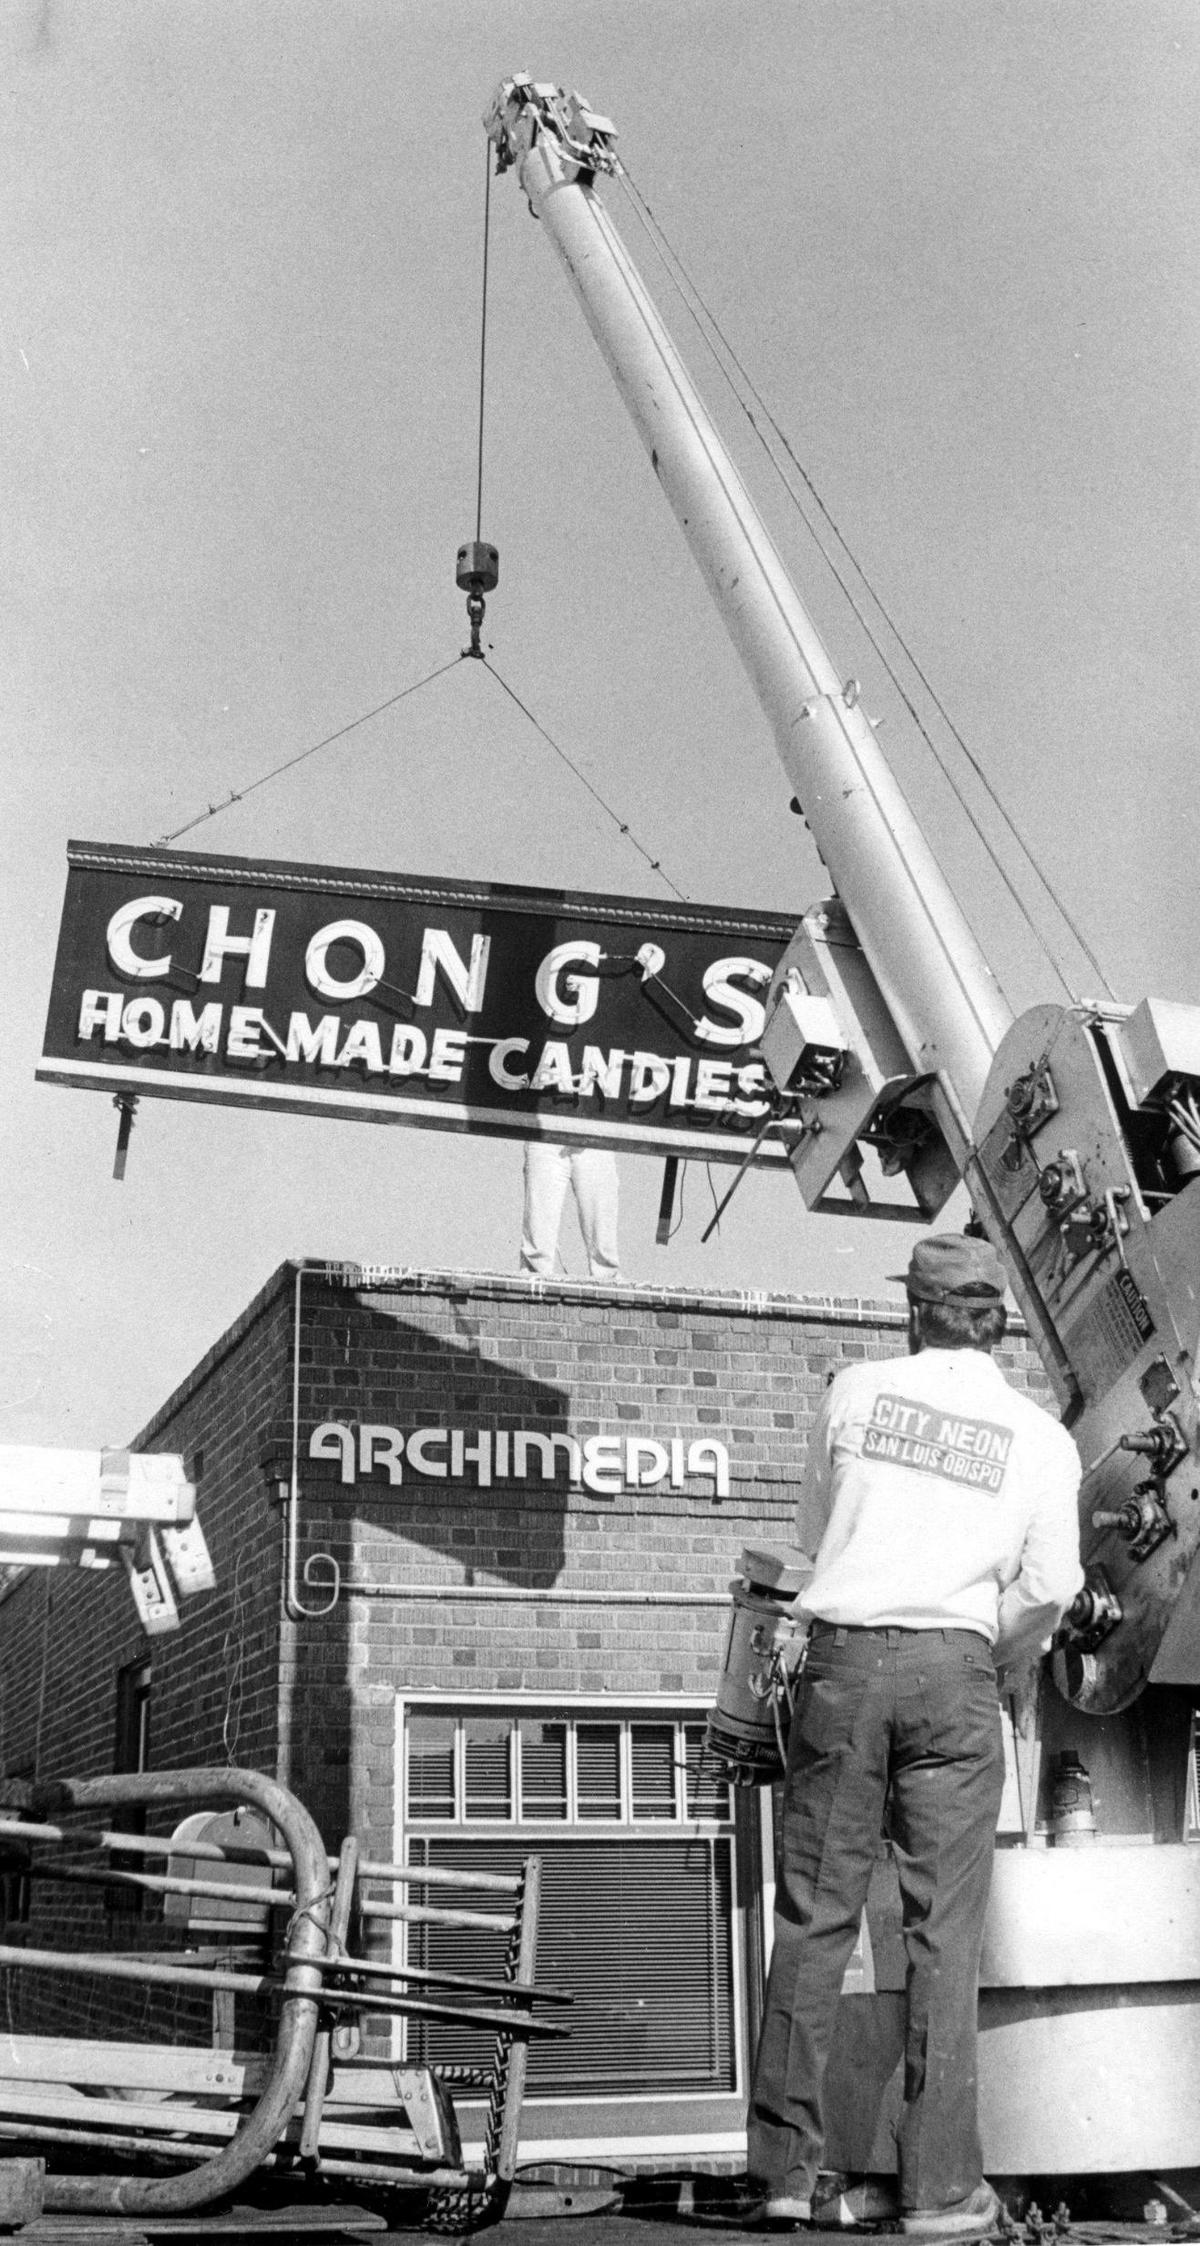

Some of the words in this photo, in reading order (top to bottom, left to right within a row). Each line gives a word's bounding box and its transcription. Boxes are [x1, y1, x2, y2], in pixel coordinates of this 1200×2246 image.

[106, 896, 774, 1045] CHONG'S
[78, 989, 264, 1058] HOME
[285, 1011, 469, 1082] MADE
[488, 1037, 771, 1117] CANDIES
[1119, 1275, 1151, 1332] CAUTION
[309, 1422, 730, 1497] ARCHIMEDIA
[866, 1431, 901, 1457] SAN
[901, 1440, 942, 1468] LUIS
[943, 1453, 1002, 1489] OBISPO
[874, 1399, 931, 1436] CITY
[937, 1419, 1011, 1463] NEON
